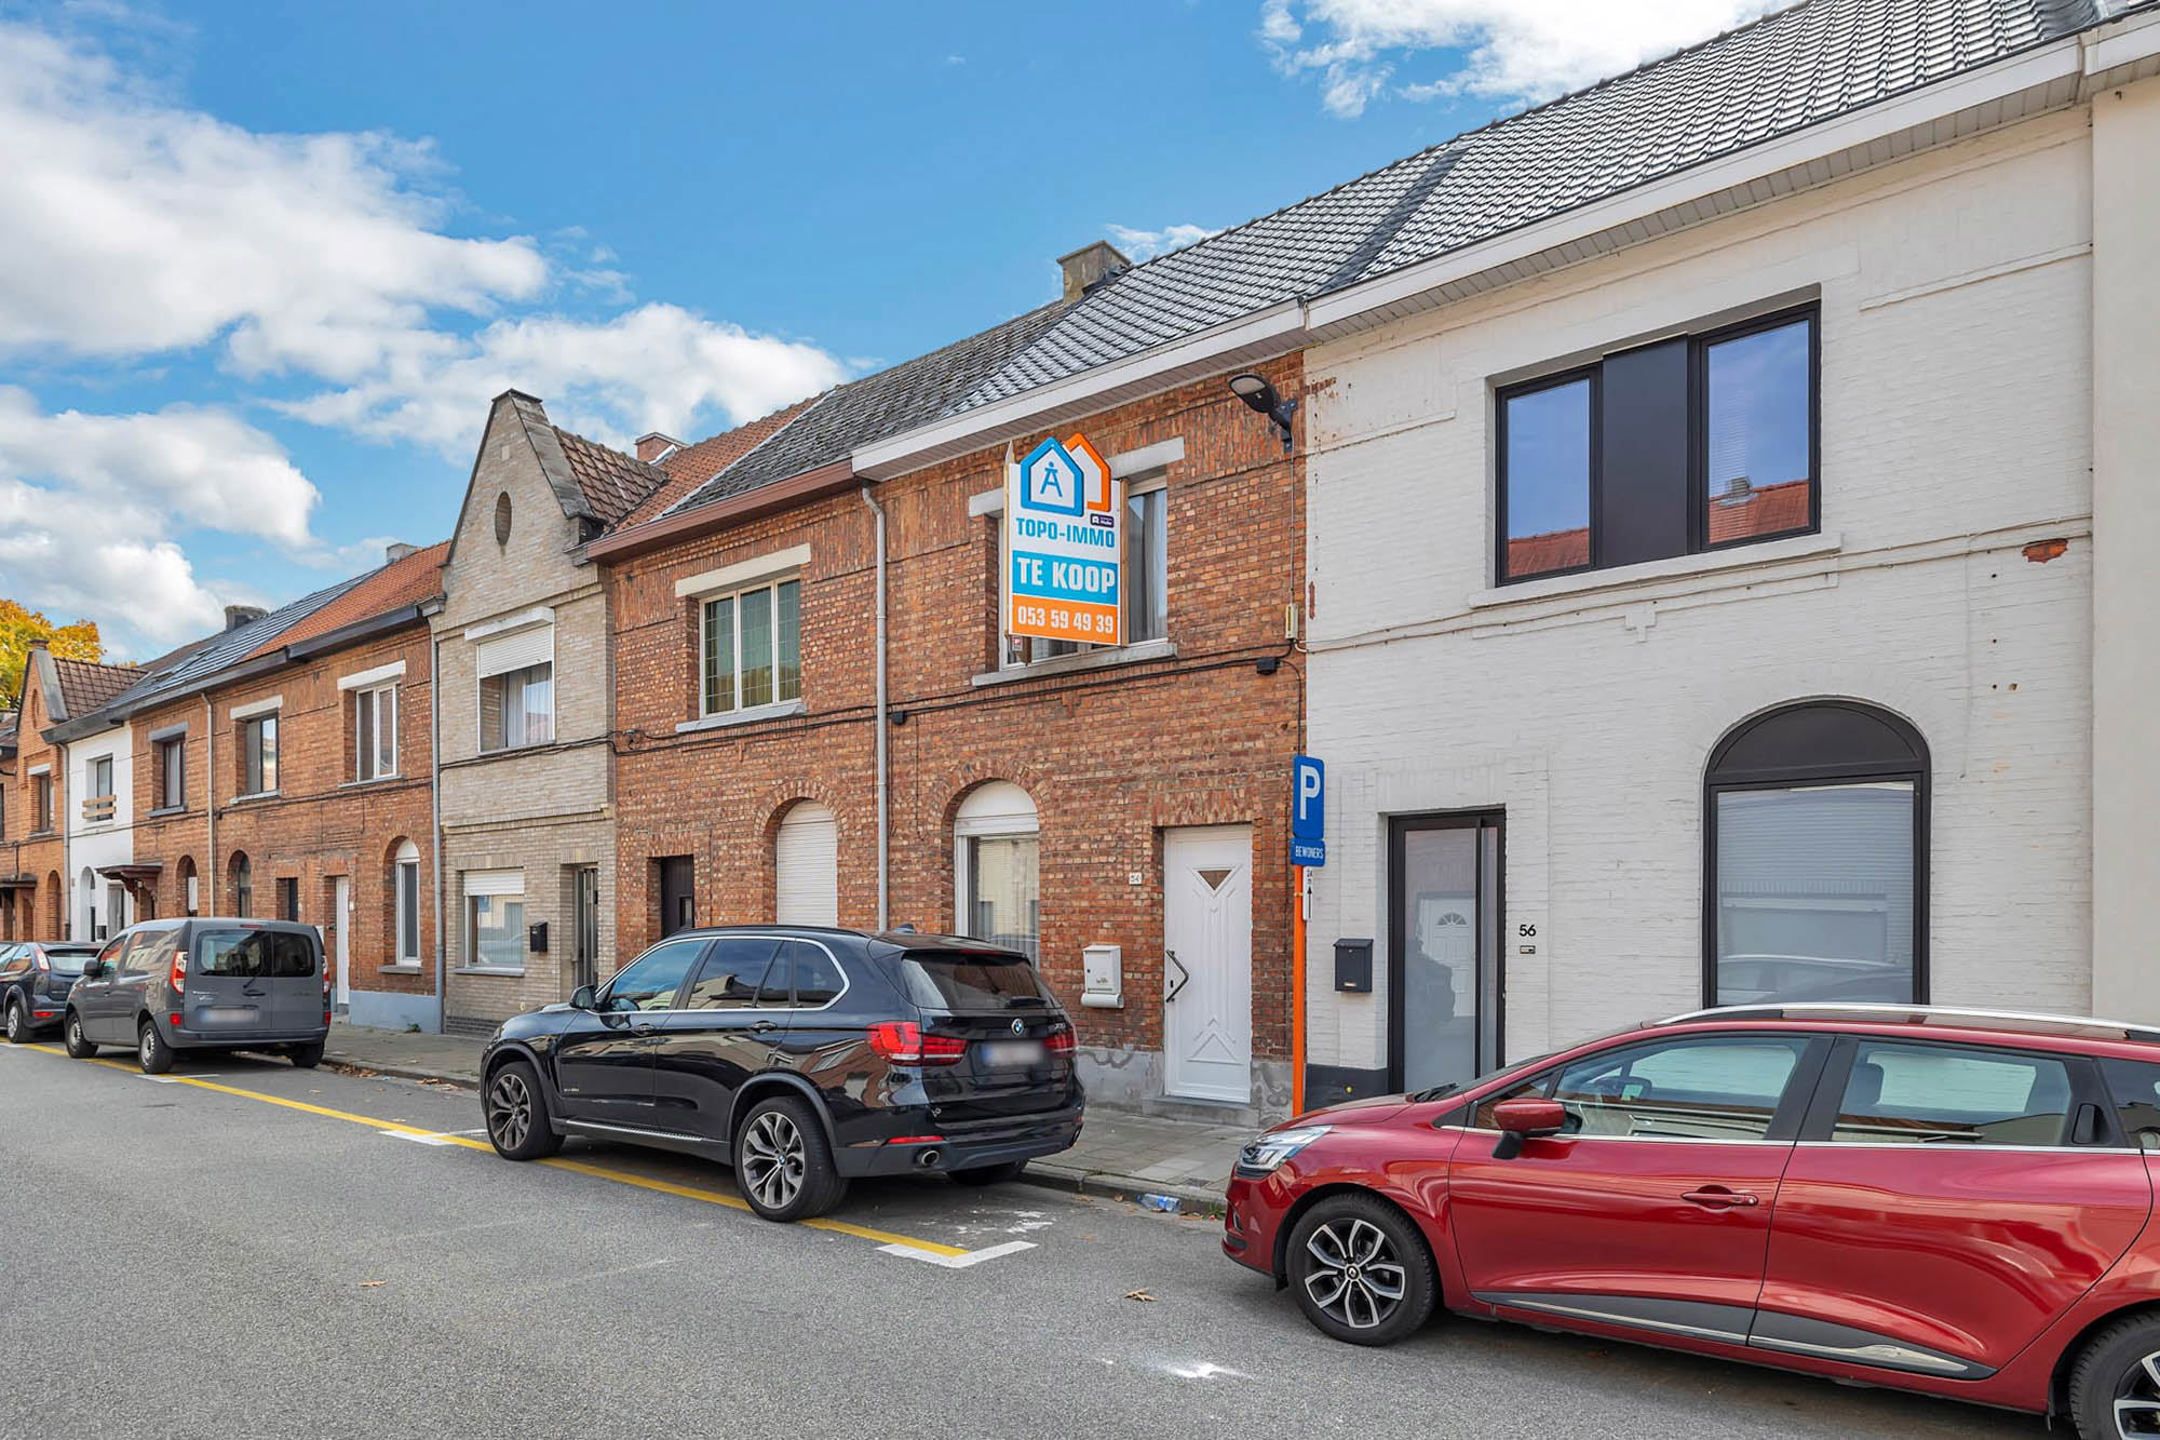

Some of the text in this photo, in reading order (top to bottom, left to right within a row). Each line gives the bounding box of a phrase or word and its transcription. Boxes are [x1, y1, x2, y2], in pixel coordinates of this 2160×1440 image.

[1016, 517, 1115, 548] TOPO-IMMO
[1017, 557, 1116, 593] TE KOOP
[1017, 606, 1114, 634] 053 59 49 39
[1300, 765, 1321, 820] P
[1295, 845, 1324, 859] BEWONERS
[1519, 924, 1537, 937] 56
